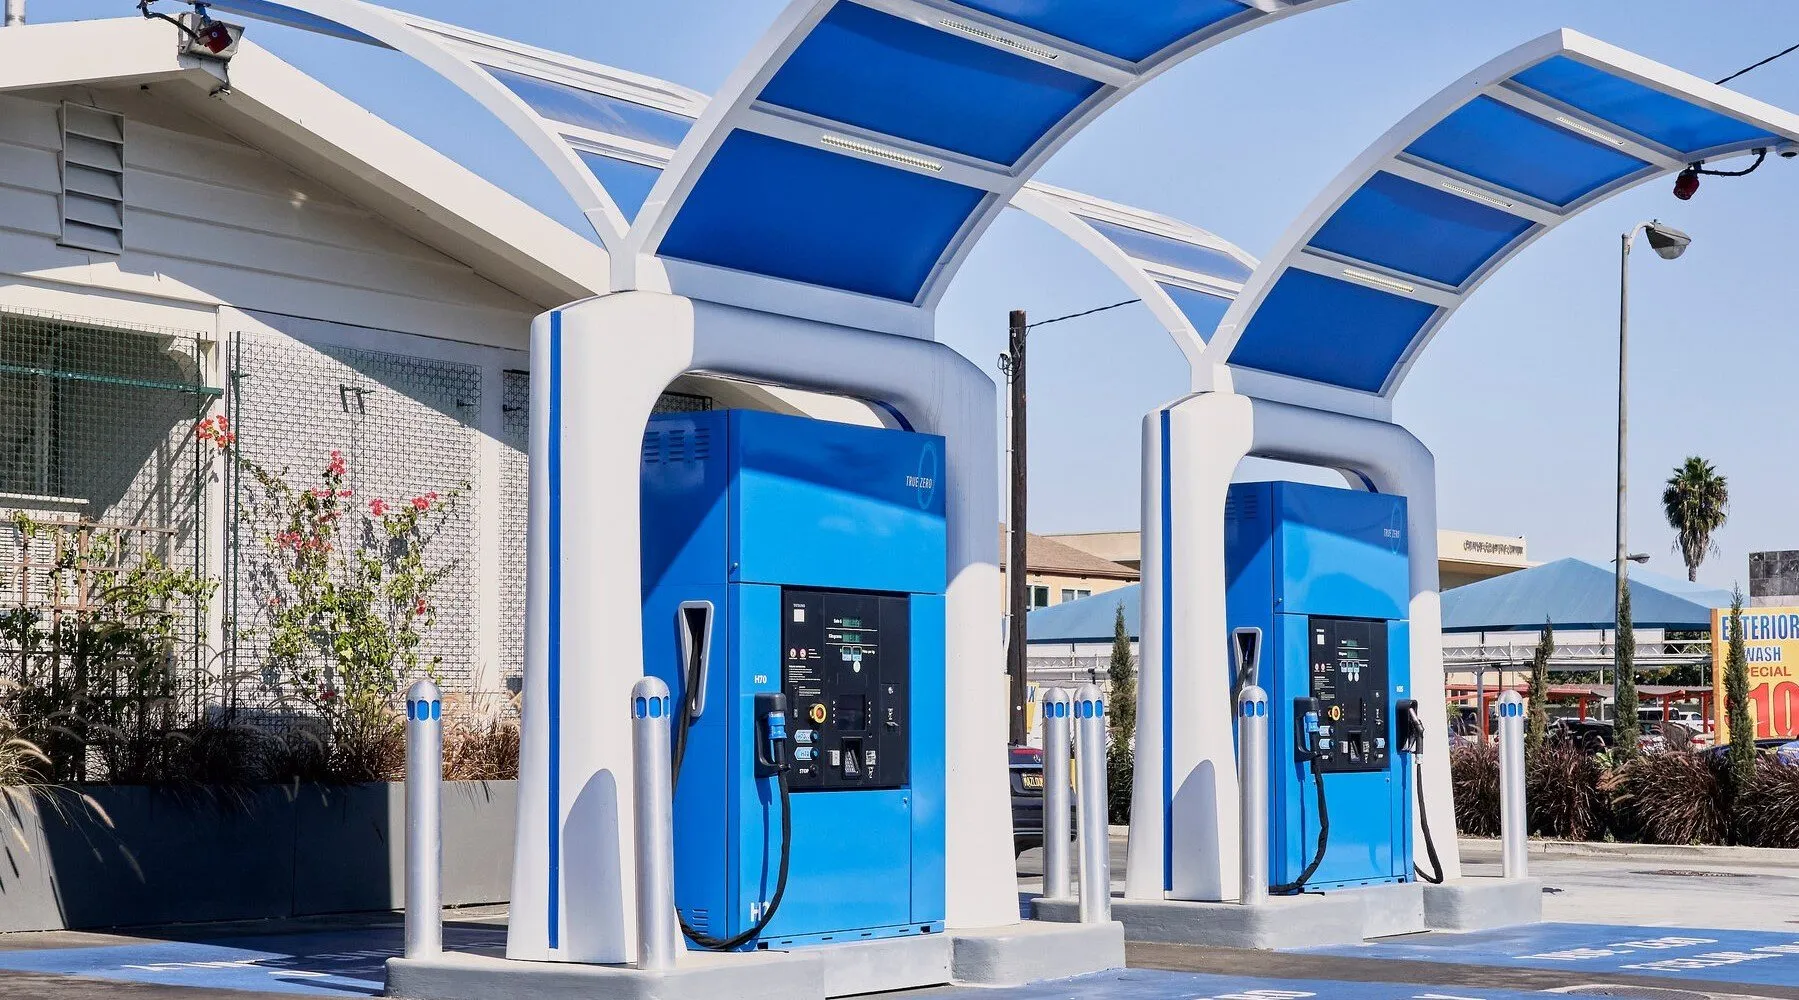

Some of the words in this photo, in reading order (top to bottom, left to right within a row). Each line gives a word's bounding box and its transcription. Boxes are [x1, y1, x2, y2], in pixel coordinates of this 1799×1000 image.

[906, 475, 919, 488] TRUE
[920, 477, 932, 489] ZERO
[1722, 614, 1799, 641] ETERIOR
[1745, 646, 1781, 662] WASH
[1745, 666, 1792, 677] ECIAL
